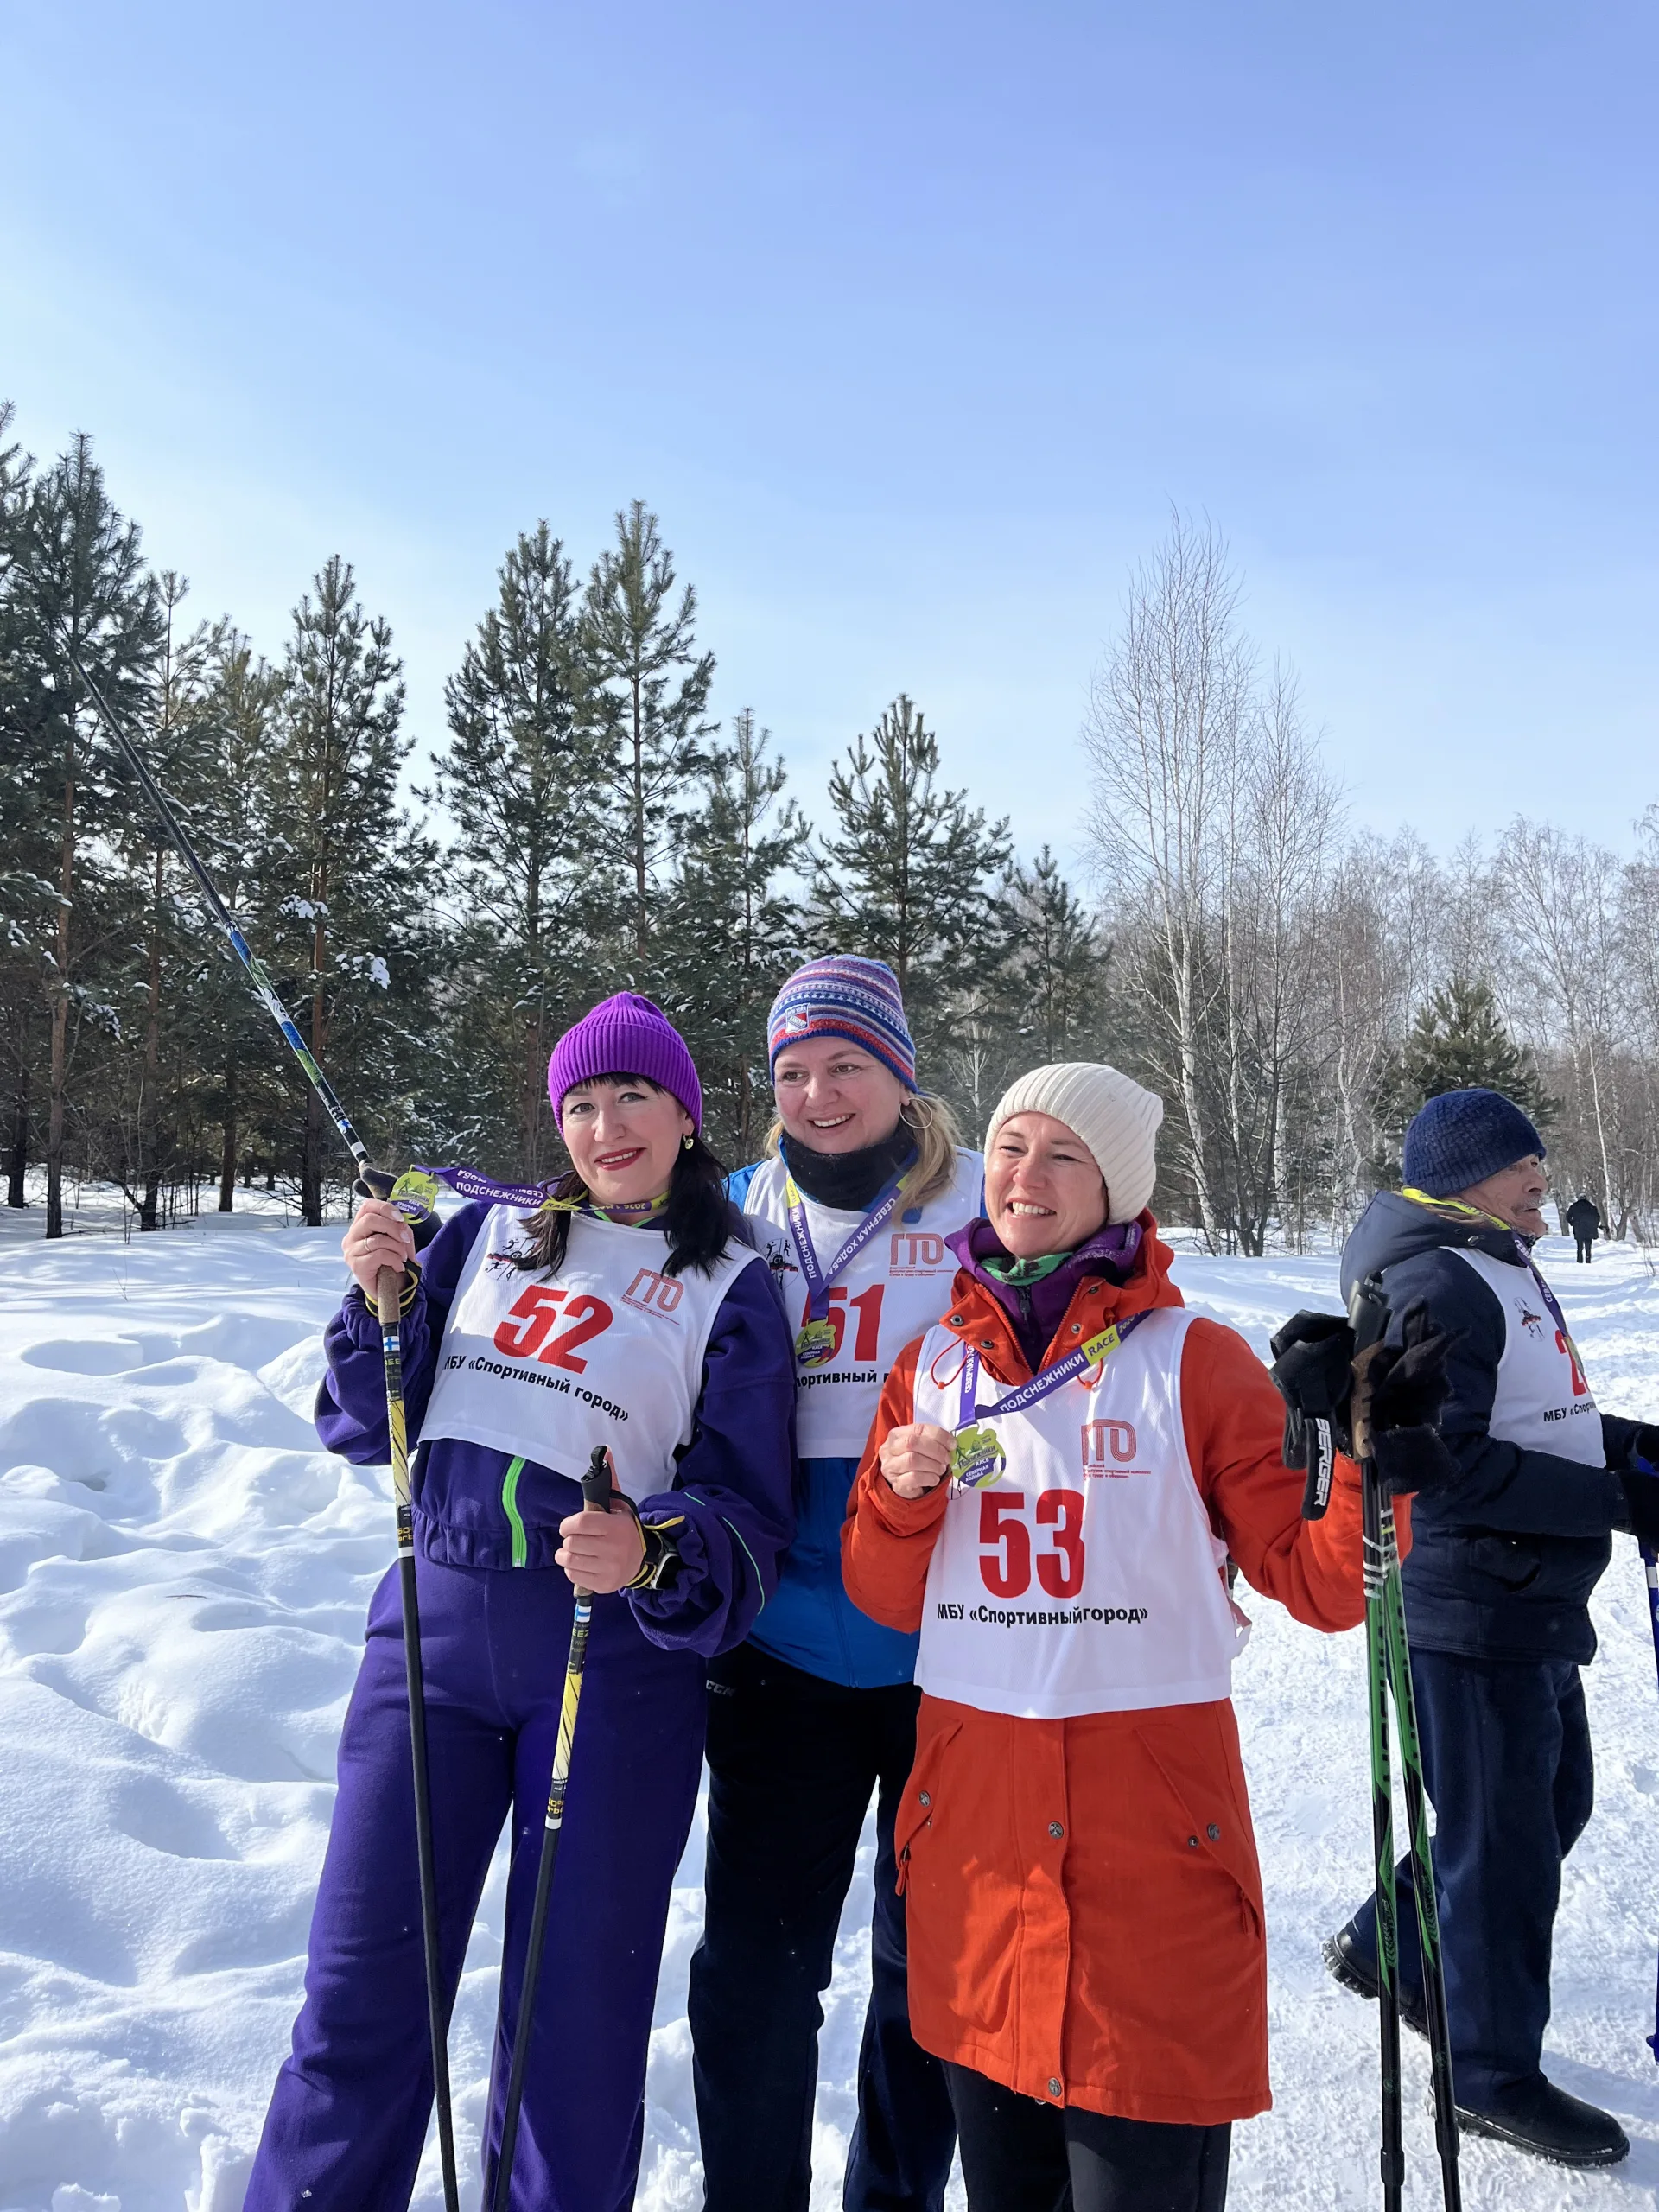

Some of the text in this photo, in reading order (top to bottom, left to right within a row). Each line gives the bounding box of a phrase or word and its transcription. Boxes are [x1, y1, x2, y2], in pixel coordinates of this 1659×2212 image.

[456, 1181, 542, 1206] ПОДСНЕЖНИКИ
[791, 1206, 817, 1279] ПОДСНЕЖНИКИ
[827, 1198, 897, 1276] СЕВЕРНАЯ ХОДЬБА
[890, 1233, 944, 1266] ГТО
[625, 1268, 684, 1313] ГТО
[493, 1284, 613, 1376] 52
[801, 1283, 886, 1363] 51
[796, 1369, 877, 1389] портивный
[964, 1357, 975, 1394] СЕВЕРНАЯ
[1000, 1353, 1084, 1413] ПОДСНЕЖНИКИ
[1088, 1332, 1116, 1357] RACE
[1555, 1329, 1590, 1397] 2
[468, 1357, 571, 1395] «Спортивный
[575, 1386, 629, 1421] город»
[1543, 1408, 1567, 1422] МБУ
[975, 1457, 990, 1467] RACE
[1080, 1418, 1137, 1466] ГТО
[1313, 1417, 1332, 1506] BERGER
[965, 1464, 990, 1478] СЕВЕРНАЯ
[978, 1488, 1086, 1599] 53
[938, 1603, 1149, 1629] МБУ «Спортивный город»
